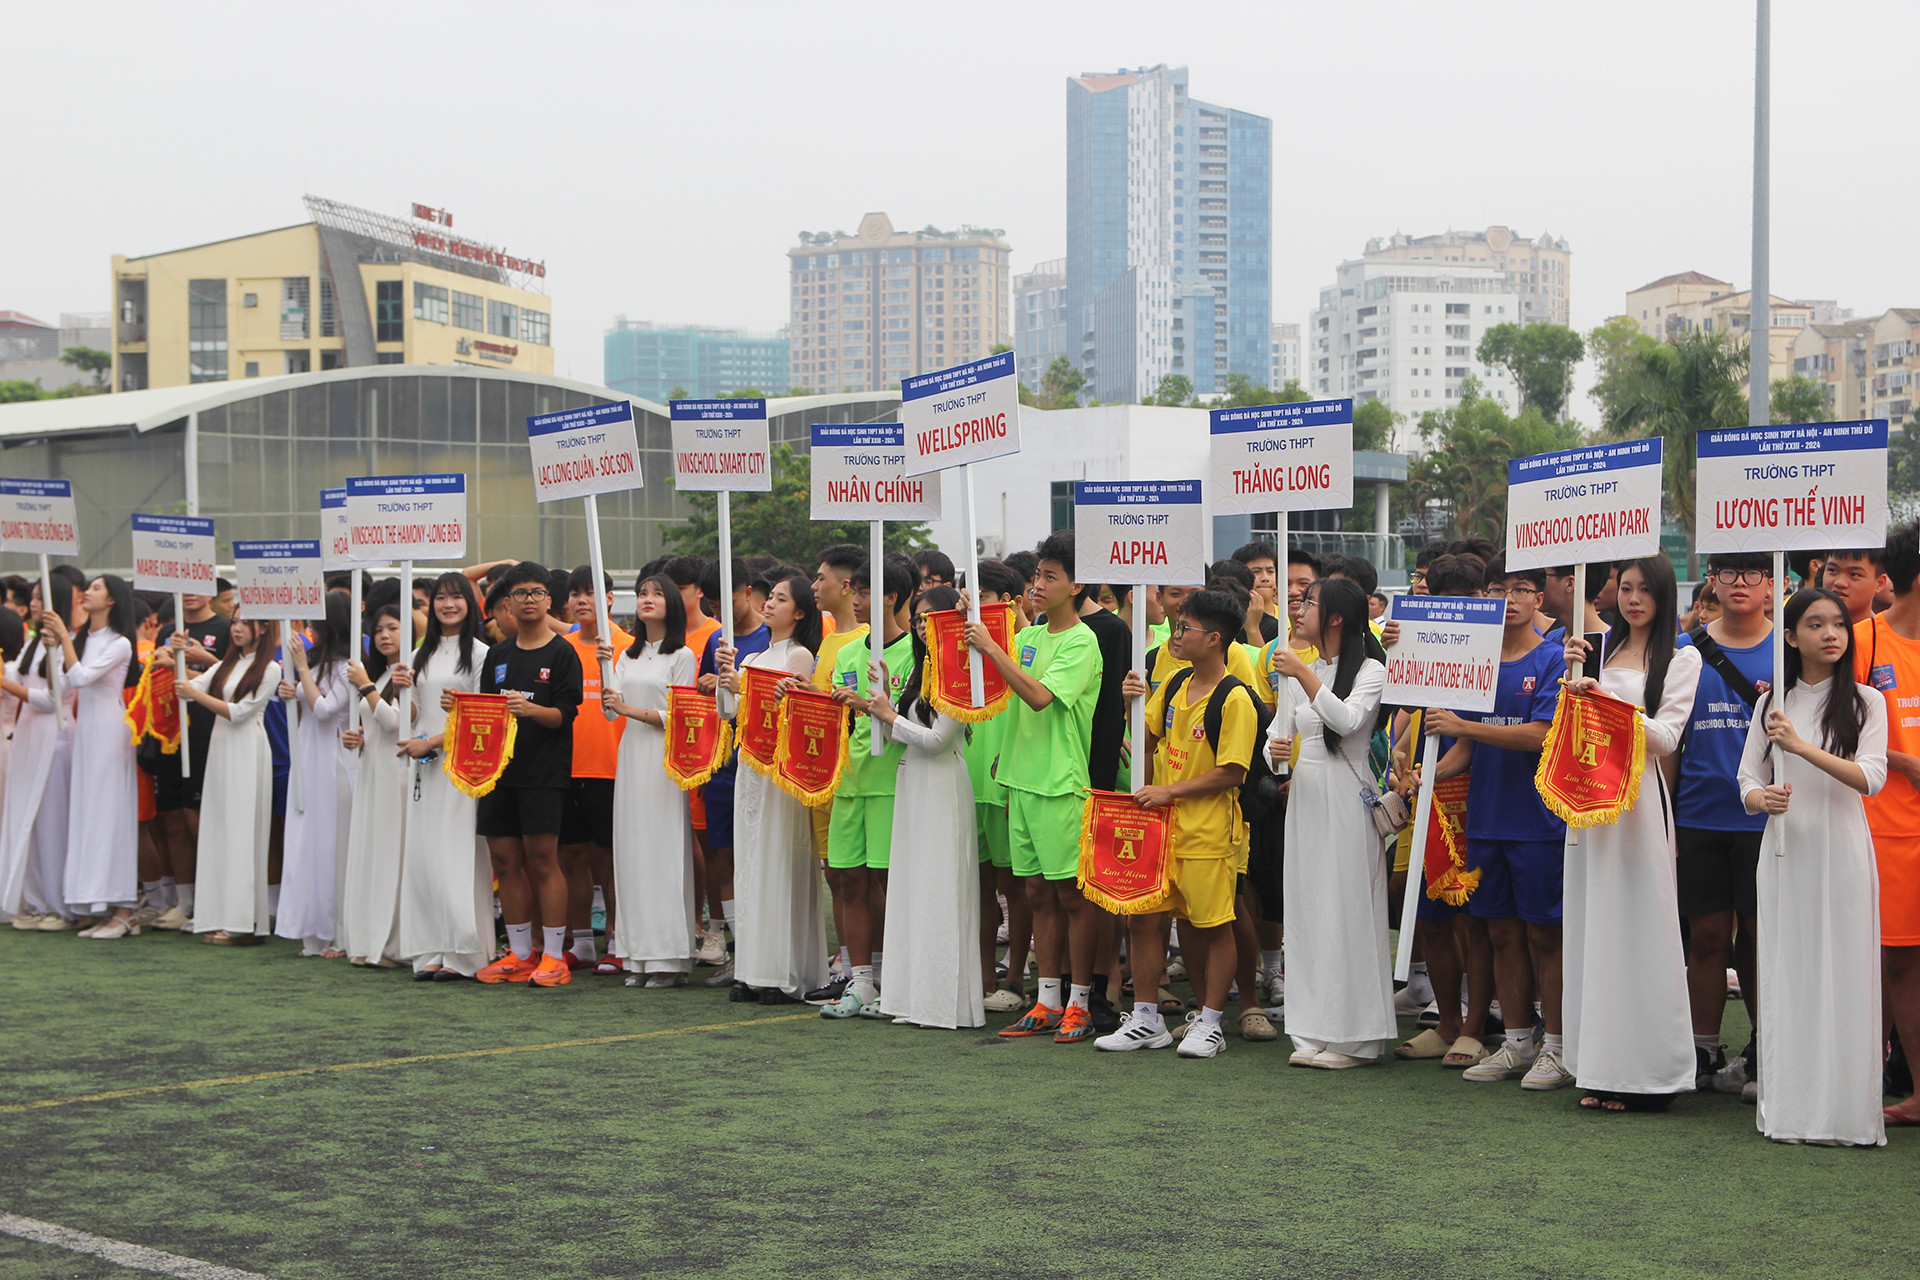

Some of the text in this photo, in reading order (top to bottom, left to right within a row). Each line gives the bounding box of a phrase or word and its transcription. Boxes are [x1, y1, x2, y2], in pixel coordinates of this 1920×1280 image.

[932, 392, 986, 414] TRƯỜNG THPT
[1250, 411, 1260, 420] HỌC
[1292, 407, 1300, 416] NỘI
[1325, 403, 1333, 412] THỦ
[695, 427, 741, 438] TRƯỜNG THPT
[916, 412, 1006, 456] WELLSPRING
[1257, 419, 1266, 428] LẦN
[1741, 432, 1749, 440] ĐÁ
[1750, 432, 1762, 442] HỌC
[1764, 431, 1778, 439] SINH
[1779, 430, 1794, 438] THPT
[1796, 428, 1804, 437] HÀ
[1806, 428, 1817, 438] NỘI
[1833, 427, 1849, 435] NINH
[1851, 424, 1862, 434] THỦ
[1864, 424, 1872, 433] ĐÔ
[556, 433, 606, 449] TRƯỜNG THPT
[1246, 438, 1314, 452] TRƯỜNG THPT
[1758, 442, 1770, 451] LẦN
[1805, 440, 1820, 449] 2024
[676, 452, 766, 473] VINSCHOOL SMART CITY
[844, 453, 905, 464] TRƯỜNG THPT
[1542, 458, 1548, 467] ĐÁ
[1549, 457, 1559, 467] HỌC
[1560, 455, 1571, 464] SINH
[1572, 453, 1584, 462] THPT
[1585, 451, 1592, 460] HÀ
[1593, 450, 1603, 460] NỘI
[1608, 448, 1615, 456] AN
[1617, 446, 1630, 455] NINH
[1631, 442, 1640, 453] THỦ
[1642, 442, 1649, 451] ĐÔ
[538, 465, 552, 488] LẠC
[551, 462, 571, 483] LONG
[571, 453, 595, 482] QUÂN
[598, 450, 615, 476] SÓC
[615, 451, 634, 473] SƠN
[1233, 462, 1329, 494] THĂNG LONG
[1556, 465, 1565, 475] LẦN
[1592, 460, 1606, 469] 2024
[1744, 463, 1835, 479] TRƯỜNG THPT
[828, 474, 922, 502] NHÂN CHÍNH
[1544, 480, 1618, 502] TRƯỜNG THPT
[377, 501, 432, 512] TRƯỜNG THPT
[1716, 485, 1864, 528] LƯƠNG THẾ VINH
[1108, 512, 1169, 524] TRƯỜNG THPT
[1515, 506, 1649, 549] VINSCHOOL OCEAN PARK
[350, 525, 383, 544] VINSCHOOL
[385, 525, 395, 543] THE
[397, 524, 425, 543] HAMONY
[447, 518, 461, 542] BIÊN
[1109, 541, 1167, 564] ALPHA
[136, 558, 158, 576] MARIE
[160, 560, 178, 577] CURIE
[192, 558, 212, 580] ĐÔNG
[1416, 630, 1469, 645] TRƯỜNG THPT
[1386, 652, 1493, 696] HOÀ BÌNH LATROBE HÀ NỘI
[1579, 743, 1597, 766] A
[1117, 841, 1136, 859] A
